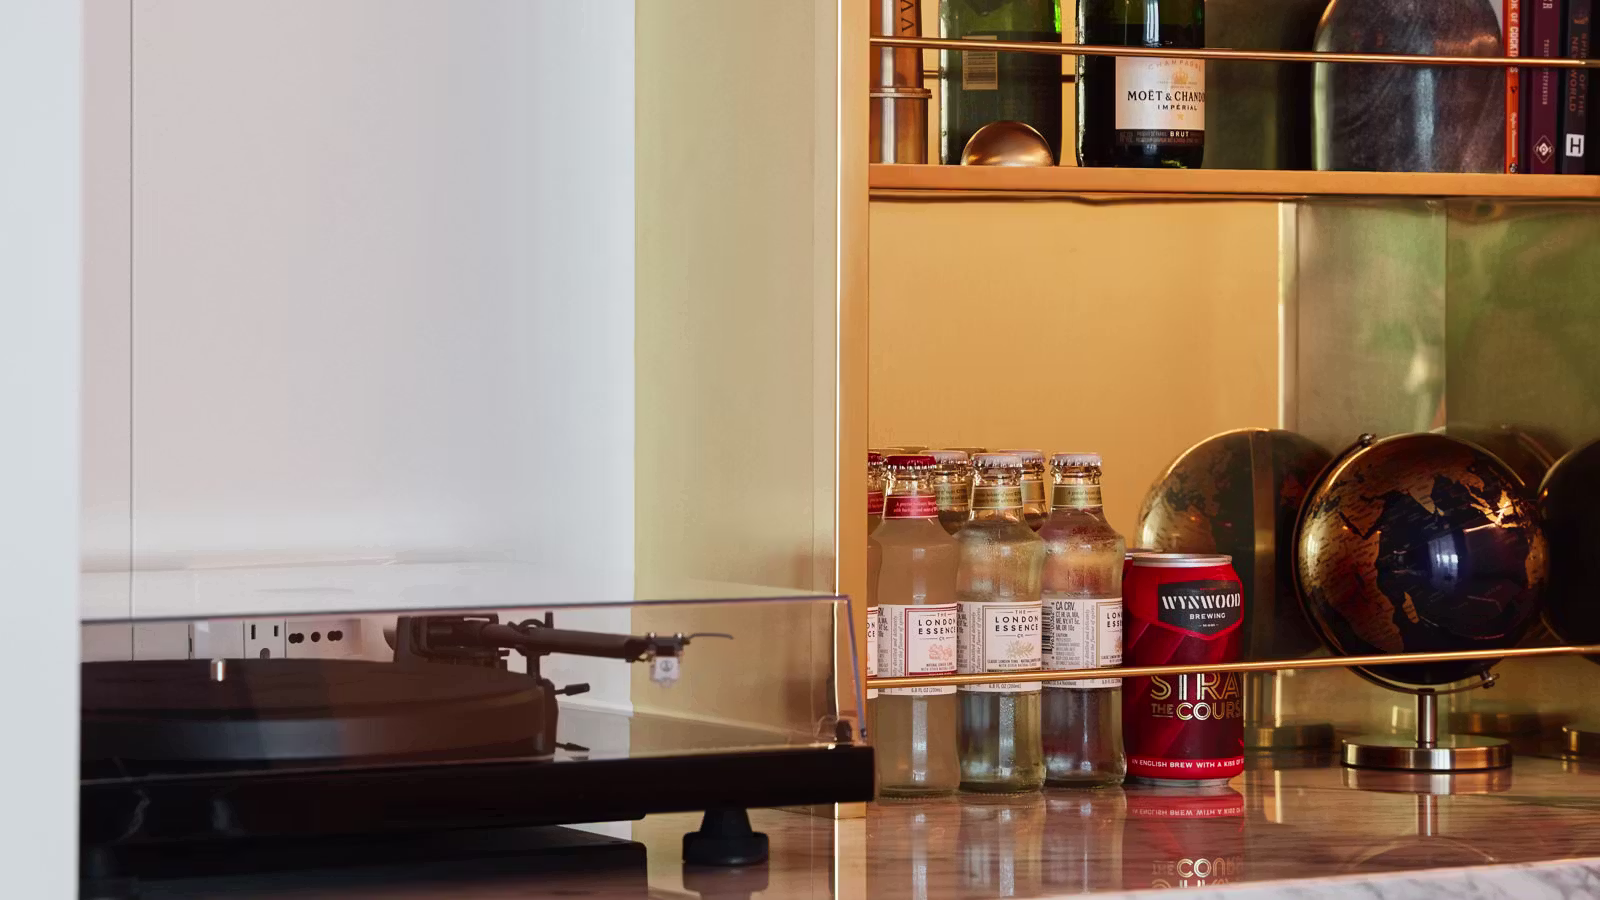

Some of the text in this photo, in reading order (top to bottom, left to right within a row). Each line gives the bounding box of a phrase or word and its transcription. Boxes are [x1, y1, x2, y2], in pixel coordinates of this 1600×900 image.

[1127, 89, 1163, 101] MOËT
[1166, 93, 1172, 101] &
[1162, 593, 1240, 609] WYNWOOD
[1150, 673, 1241, 700] STRA
[1151, 704, 1174, 714] THE
